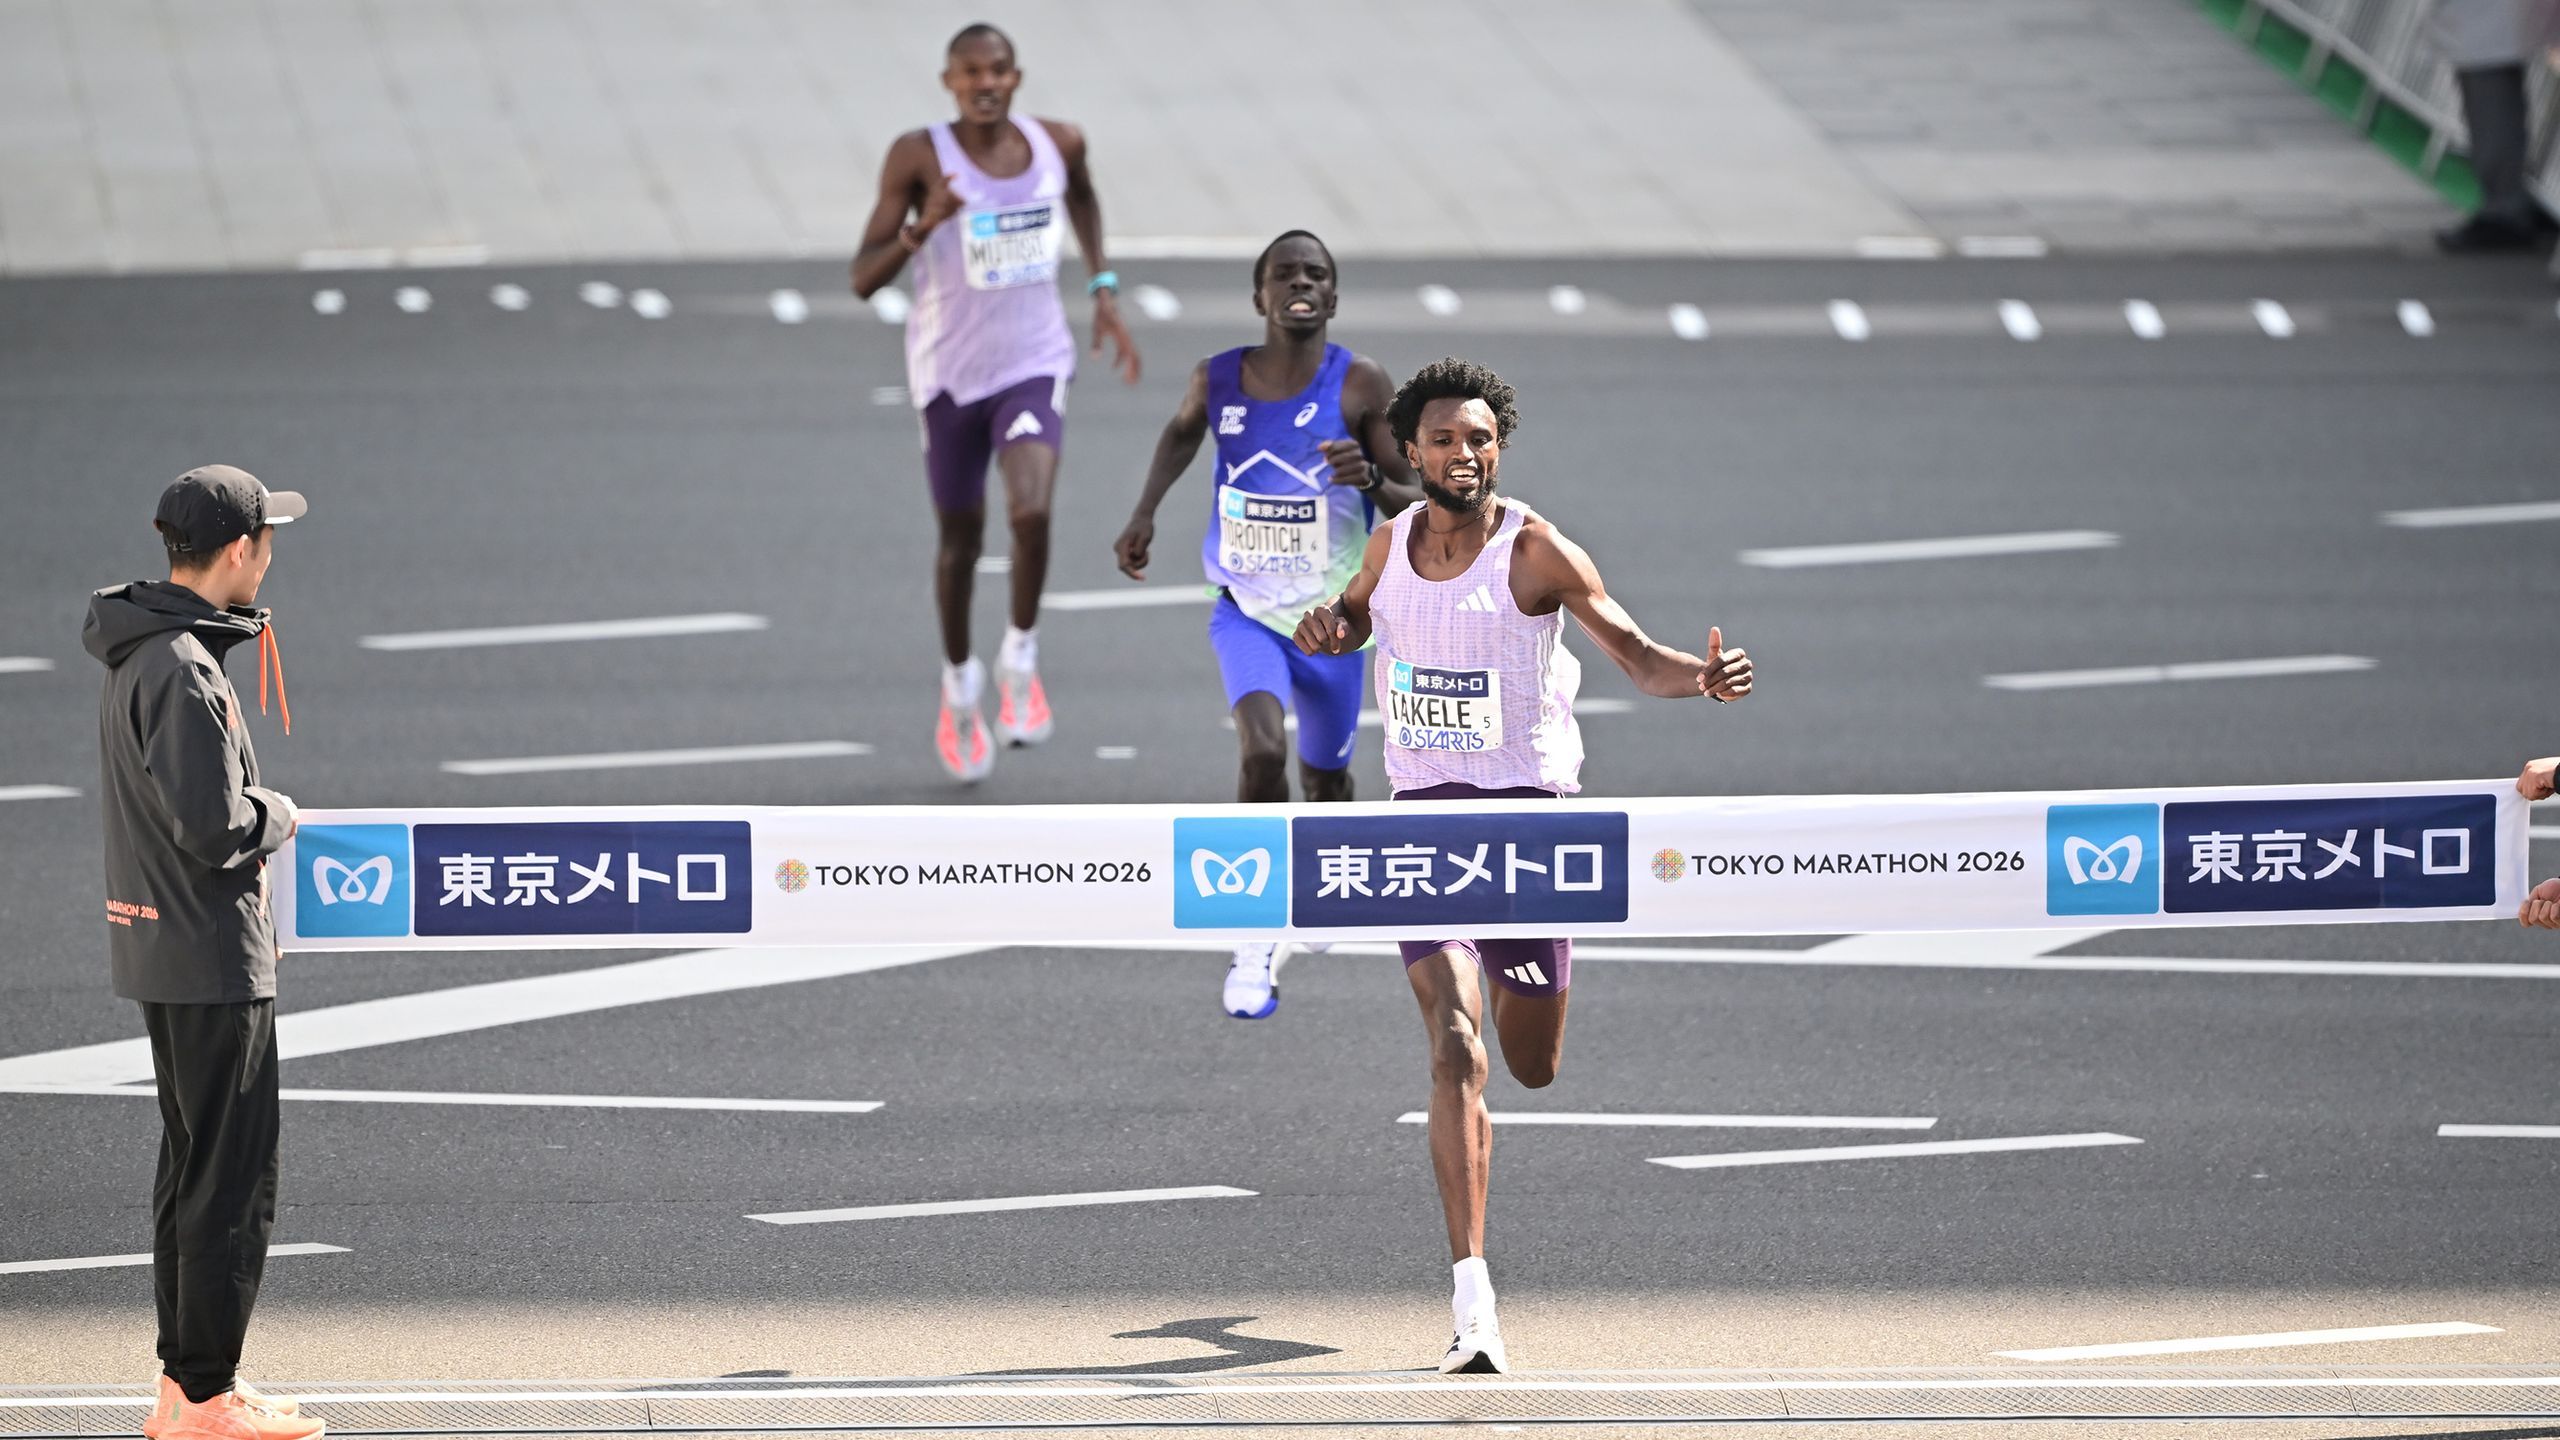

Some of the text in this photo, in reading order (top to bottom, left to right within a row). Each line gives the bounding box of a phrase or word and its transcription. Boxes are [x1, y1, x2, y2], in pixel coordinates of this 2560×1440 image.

[1246, 502, 1313, 519] 東京メトロ
[1222, 517, 1301, 553] TOROITICH
[1415, 674, 1484, 692] 東京メトロ
[1390, 689, 1472, 729] TAKELE
[1483, 716, 1491, 729] 5
[1316, 843, 1603, 899] 東京メトロ
[1691, 851, 2026, 876] TOKYO MARATHON 2026
[2187, 828, 2471, 884] 東京メトロ
[438, 852, 727, 908] 東京メトロ
[815, 862, 1152, 886] TOKYO MARATHON 2026
